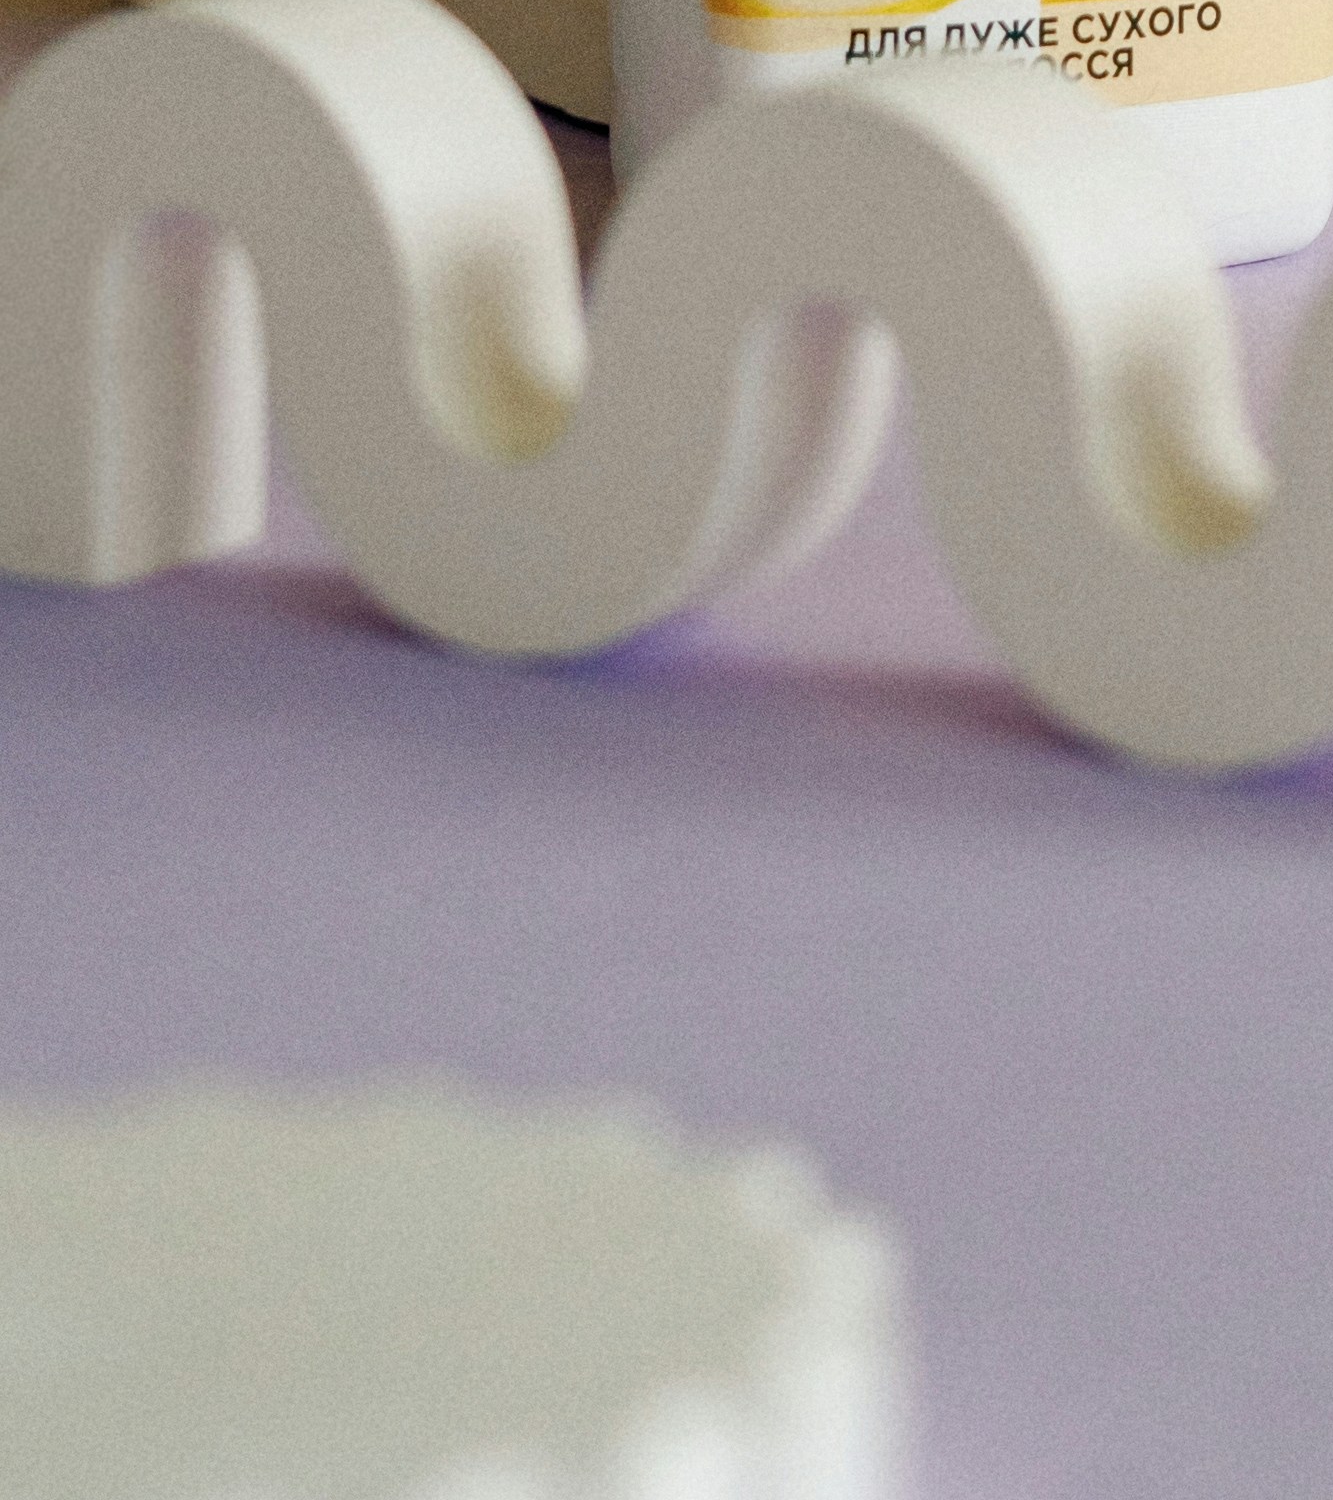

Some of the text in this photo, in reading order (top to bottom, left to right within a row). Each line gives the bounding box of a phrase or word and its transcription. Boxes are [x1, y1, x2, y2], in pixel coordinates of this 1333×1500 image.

[845, 1, 1222, 66] ДЛЯ ДУЖЕ СУХОГО
